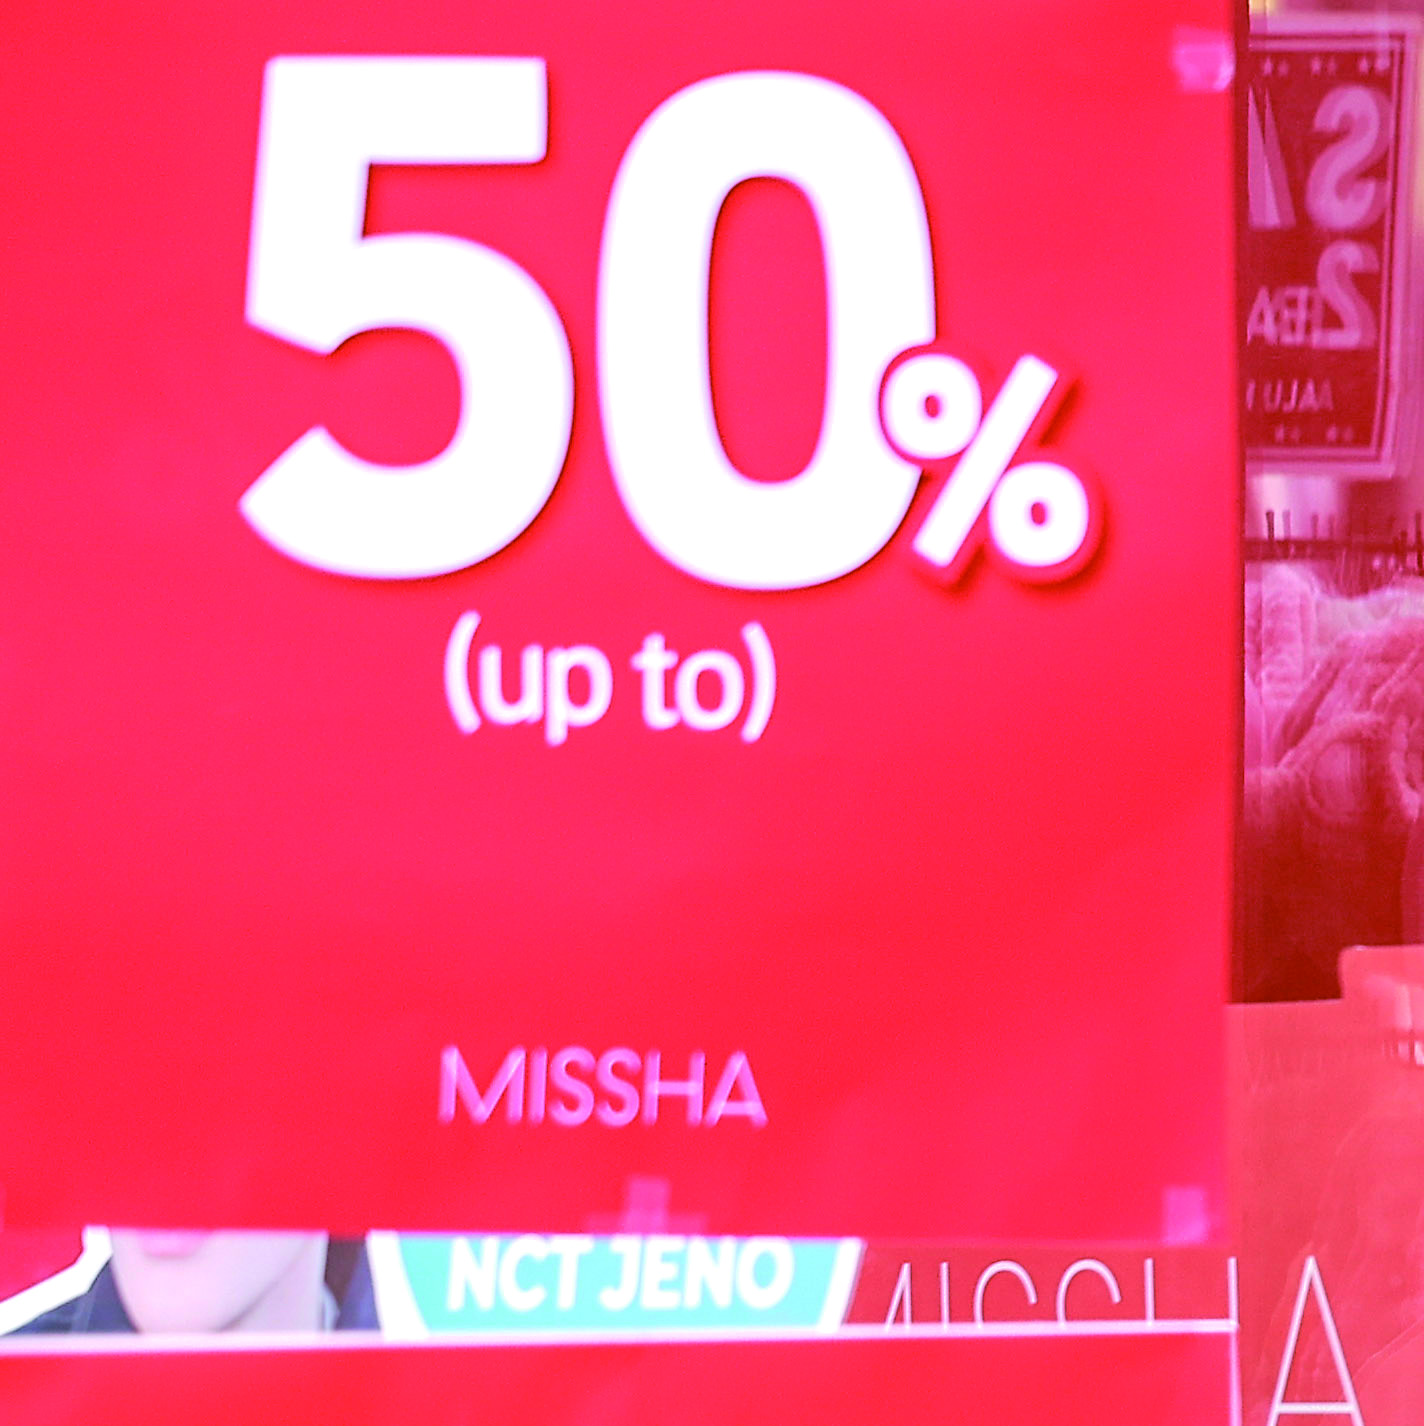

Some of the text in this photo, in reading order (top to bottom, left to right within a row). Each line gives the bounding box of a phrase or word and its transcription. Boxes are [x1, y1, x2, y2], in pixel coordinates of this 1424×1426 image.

[239, 55, 1090, 592] 50%
[444, 610, 779, 747] (up to)
[437, 1045, 768, 1127] MISSHA
[446, 1234, 795, 1312] NCT JENO
